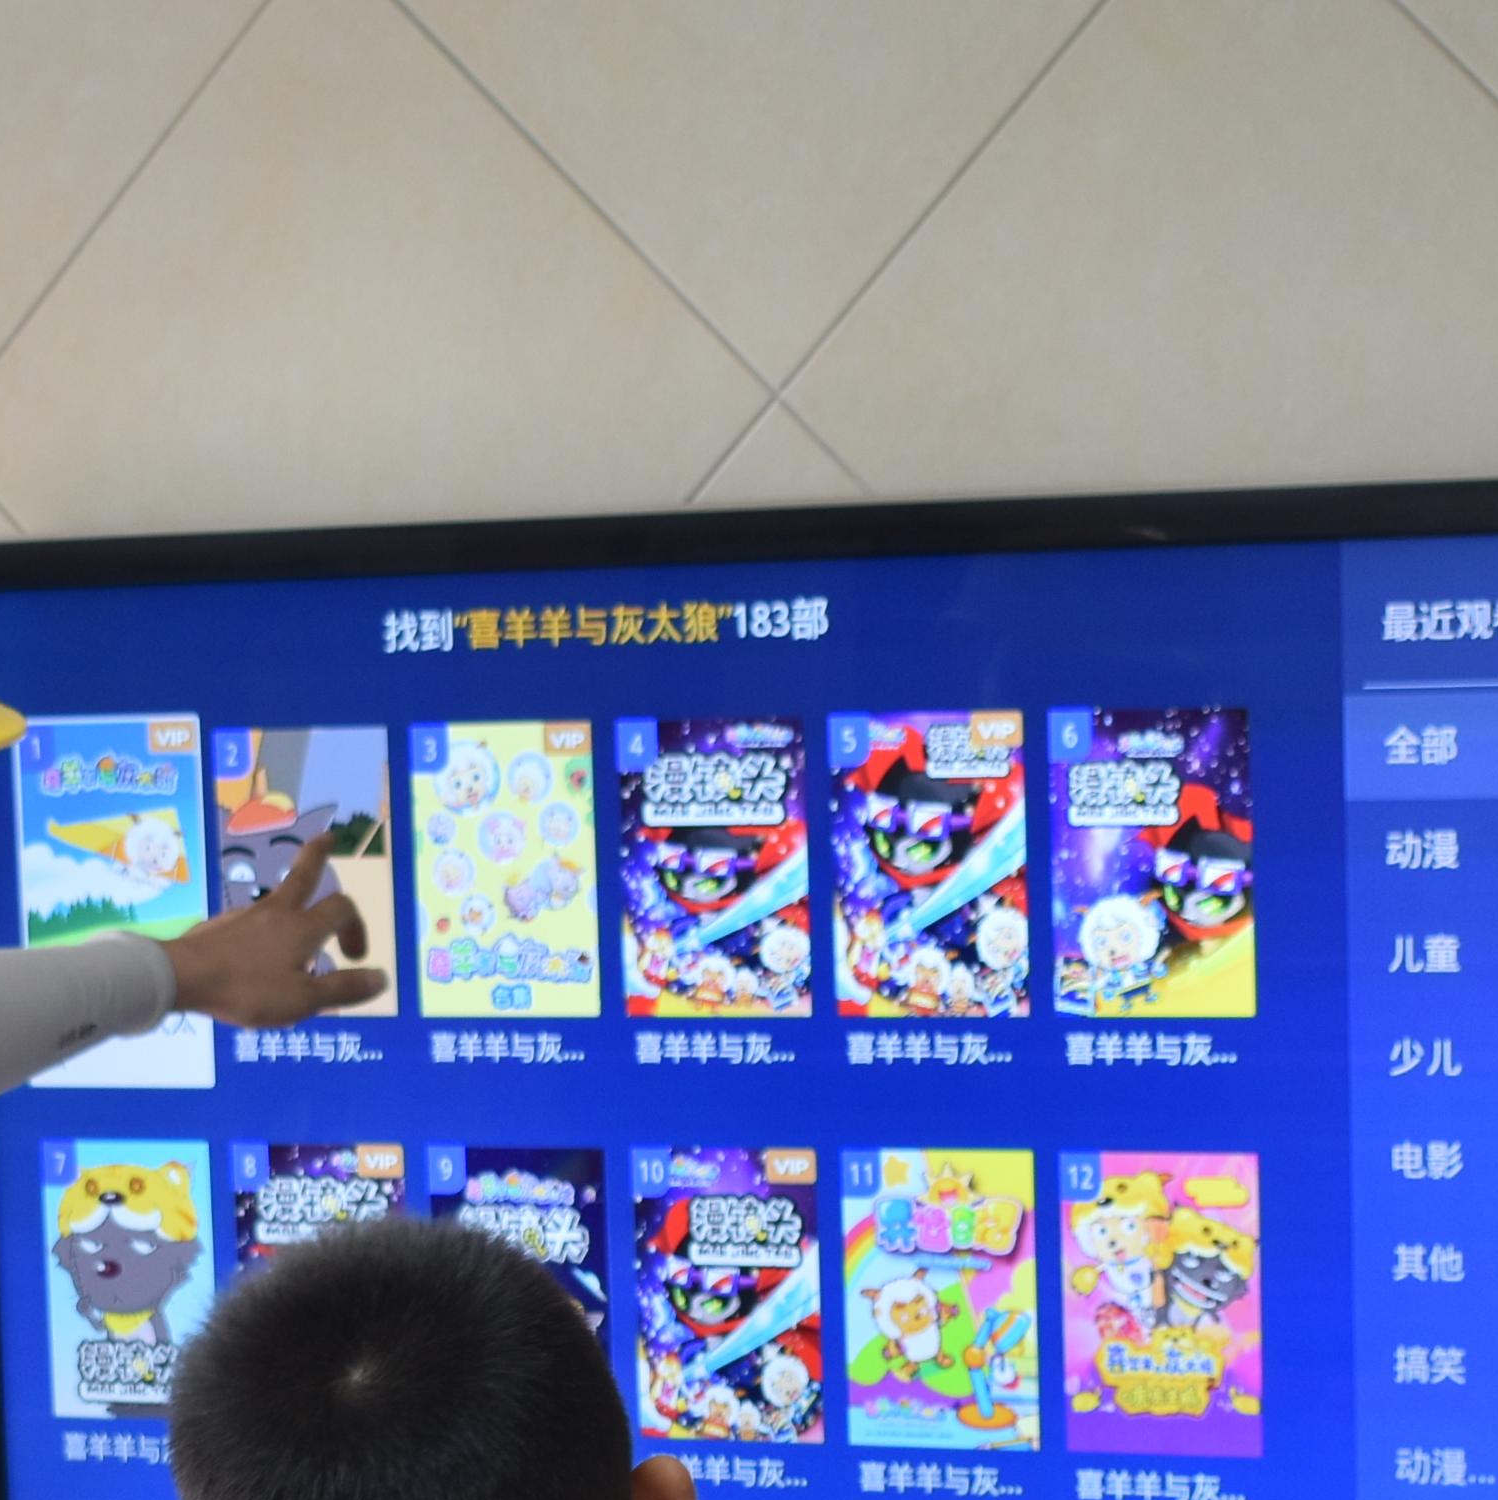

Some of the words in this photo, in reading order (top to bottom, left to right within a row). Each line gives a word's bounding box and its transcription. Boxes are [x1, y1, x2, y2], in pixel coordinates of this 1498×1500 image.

[156, 729, 191, 747] VIP
[550, 731, 585, 750] VIP
[628, 726, 644, 755] 4
[841, 727, 857, 754] 5
[976, 720, 1016, 740] VIP
[1062, 722, 1078, 749] 6
[227, 742, 239, 767] 2
[424, 738, 437, 763] 3
[1385, 725, 1458, 765] 全部
[1386, 829, 1460, 869] 动漫
[1389, 934, 1461, 973] 儿童
[1389, 1037, 1462, 1077] 少儿
[53, 1152, 67, 1176] 7
[244, 1154, 257, 1178] 8
[365, 1154, 397, 1170] VIP
[439, 1155, 453, 1181] 9
[638, 1160, 664, 1185] 10
[773, 1158, 810, 1175] VIP
[1391, 1141, 1464, 1179] 电影
[848, 1161, 874, 1187] 11
[1067, 1165, 1094, 1190] 12
[1392, 1243, 1465, 1282] 其他
[1393, 1345, 1466, 1385] 搞笑
[651, 1452, 809, 1488] 羊羊与灰...
